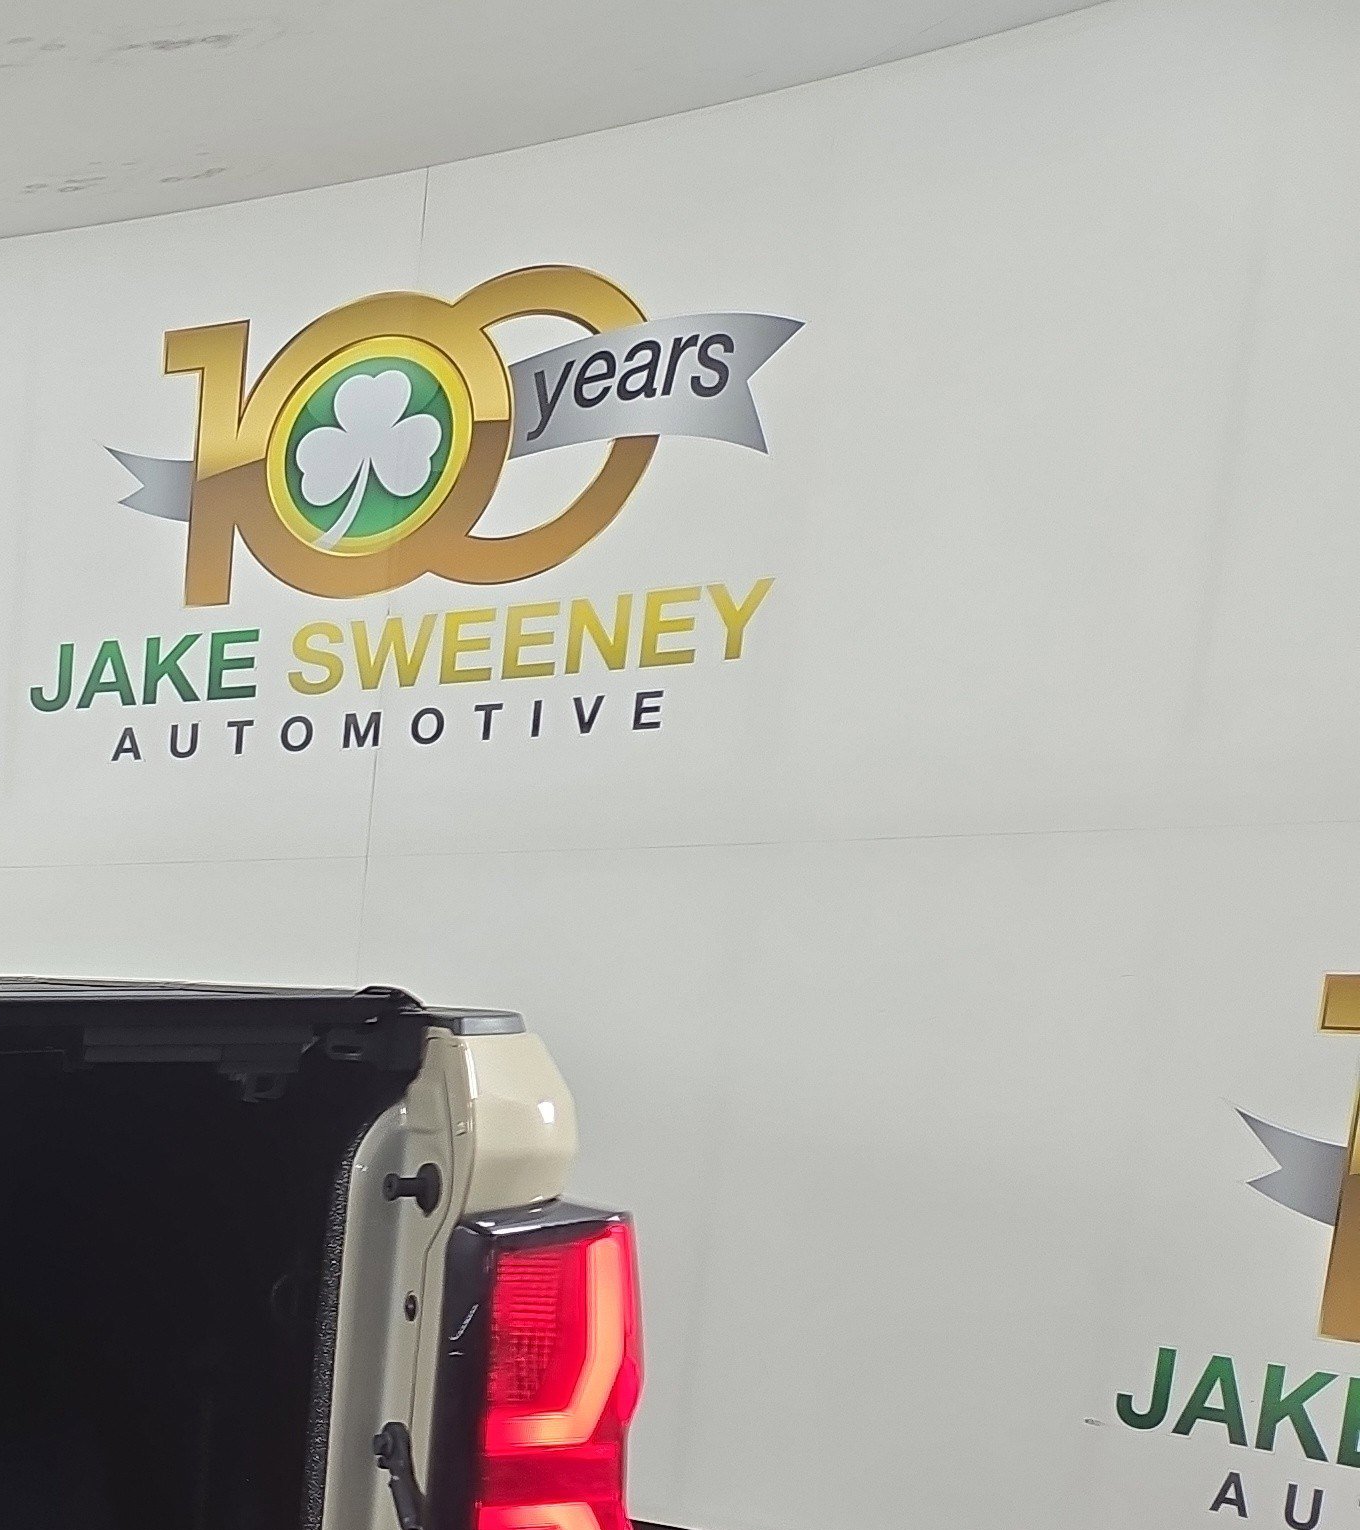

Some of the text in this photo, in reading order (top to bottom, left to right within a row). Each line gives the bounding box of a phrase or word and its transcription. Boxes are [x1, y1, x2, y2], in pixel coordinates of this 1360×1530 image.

[162, 263, 735, 609] 100 years
[30, 578, 774, 712] JAKE SWEENEY
[110, 690, 665, 763] AUTOMOTIVE
